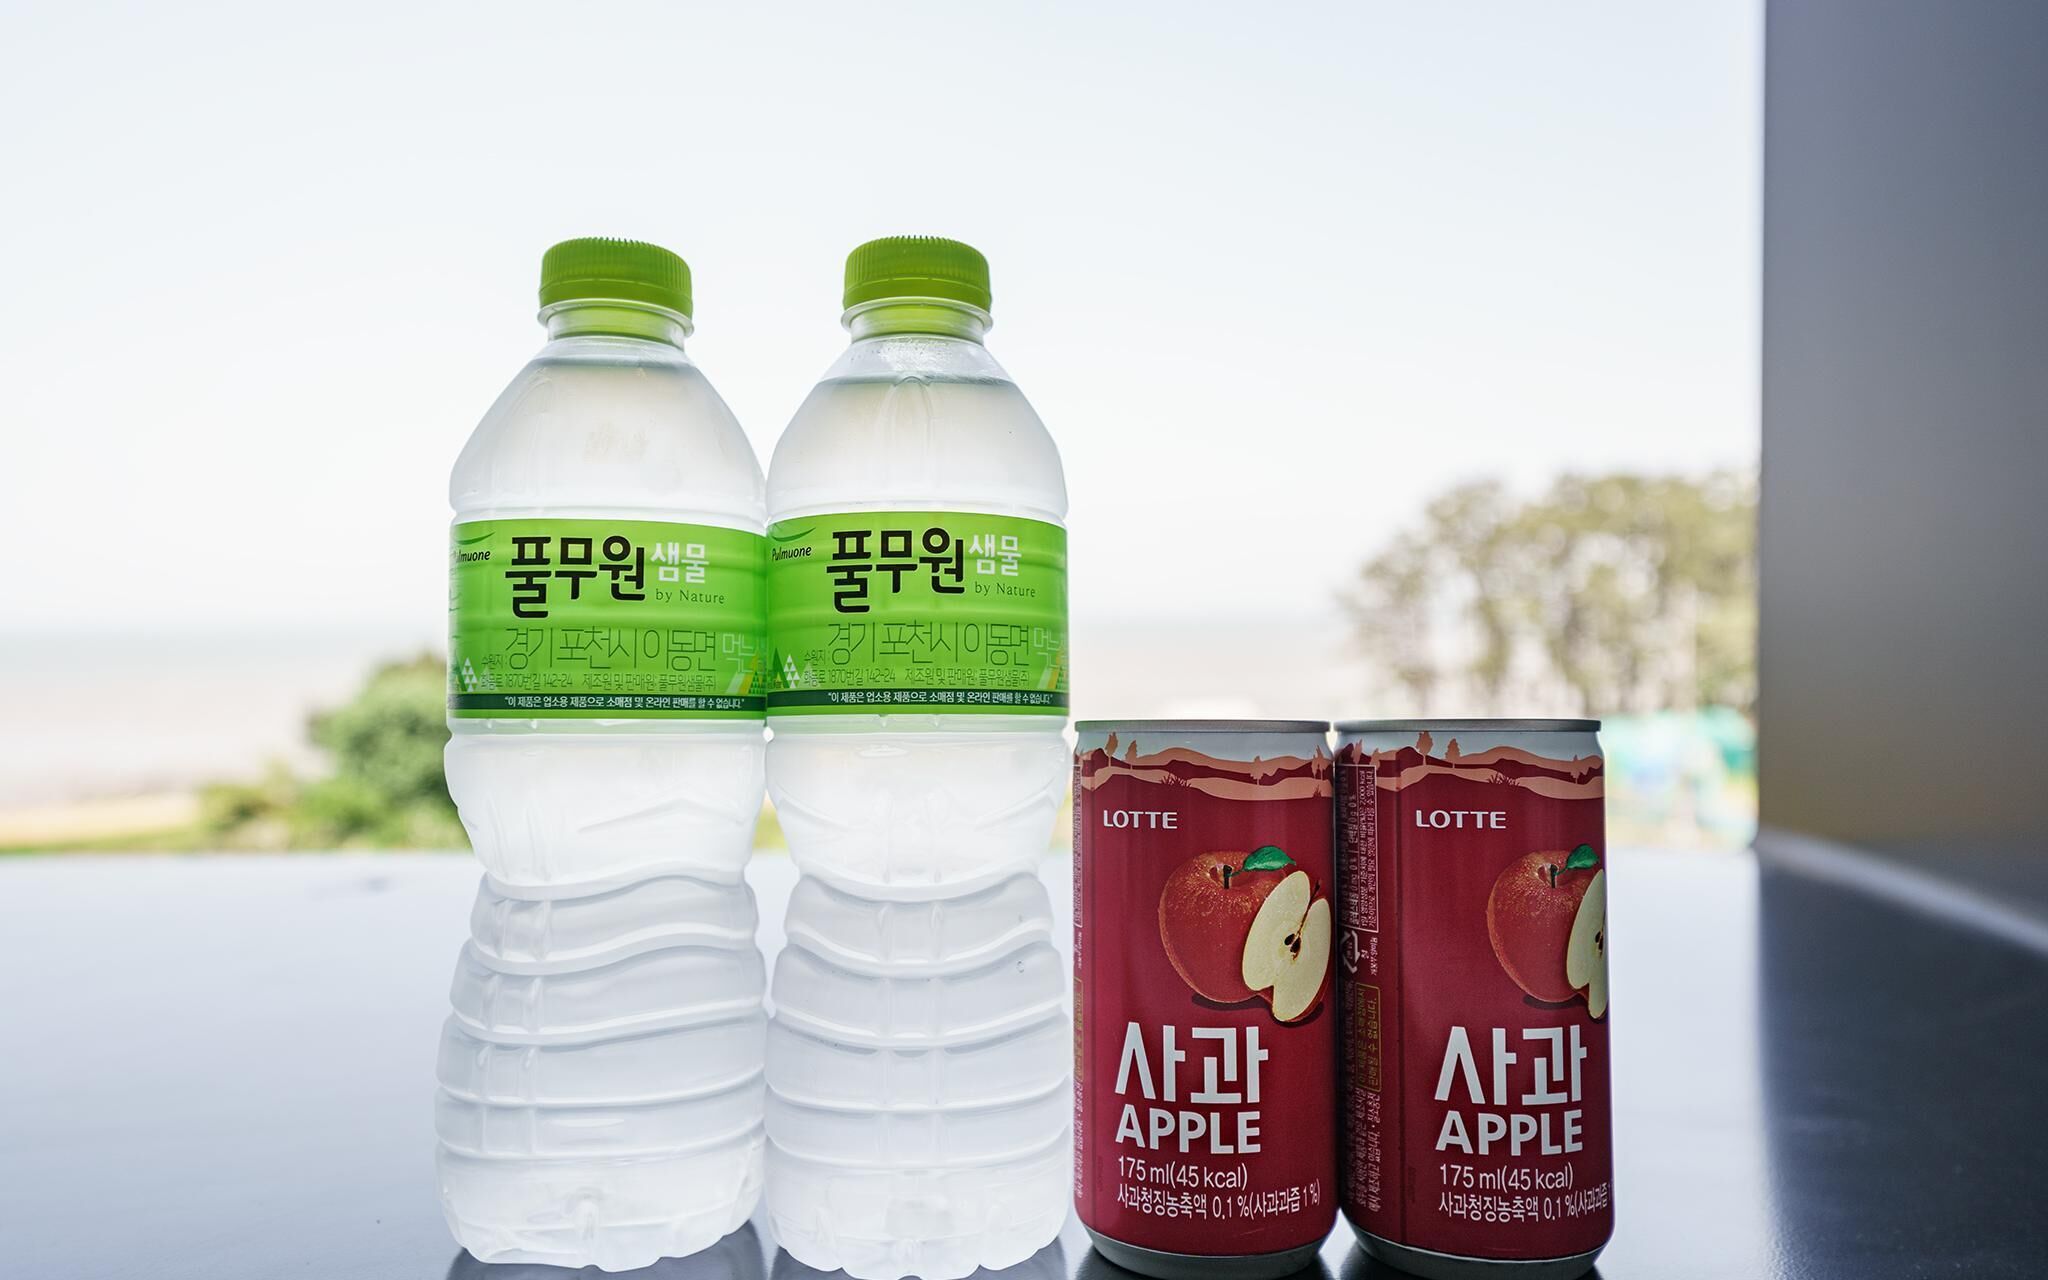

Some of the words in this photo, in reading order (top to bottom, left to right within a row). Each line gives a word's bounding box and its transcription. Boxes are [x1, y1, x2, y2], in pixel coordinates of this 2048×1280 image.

[772, 547, 812, 561] Pulmuone
[827, 527, 965, 613] 풀무원
[968, 534, 1022, 577] 샘물
[505, 535, 645, 618] 풀무원
[650, 542, 710, 584] 샘물
[975, 582, 990, 596] by
[997, 582, 1036, 597] Nature
[656, 588, 672, 602] by
[680, 589, 724, 604] Nature
[506, 627, 552, 669] 경기
[557, 627, 637, 670] 포천시
[643, 629, 716, 671] 이동면
[828, 622, 875, 665] 경기
[880, 620, 958, 663] 포천시
[964, 623, 1029, 665] 이동면
[517, 696, 542, 707] 제품은
[543, 697, 568, 707] 업소용
[570, 696, 603, 707] 제품으로
[607, 697, 632, 708] 소매점
[646, 698, 671, 708] 온라인
[841, 692, 864, 703] 제품은
[866, 692, 891, 702] 업소용
[893, 692, 927, 702] 제품으로
[930, 691, 954, 703] 소매점
[967, 692, 990, 703] 온라인
[1103, 811, 1178, 830] LOTTE
[1416, 810, 1506, 830] LOTTE
[1115, 1022, 1268, 1105] 사과
[1434, 1025, 1587, 1106] 사과
[1115, 1104, 1261, 1154] APPLE
[1436, 1109, 1582, 1155] APPLE
[1118, 1155, 1145, 1181] 175
[1204, 1160, 1247, 1188] kcal)
[1440, 1164, 1474, 1187] 175
[1535, 1161, 1574, 1189] kcal)
[1117, 1183, 1207, 1220] 사과청징농축액
[1438, 1194, 1539, 1223] 사과청징농축액
